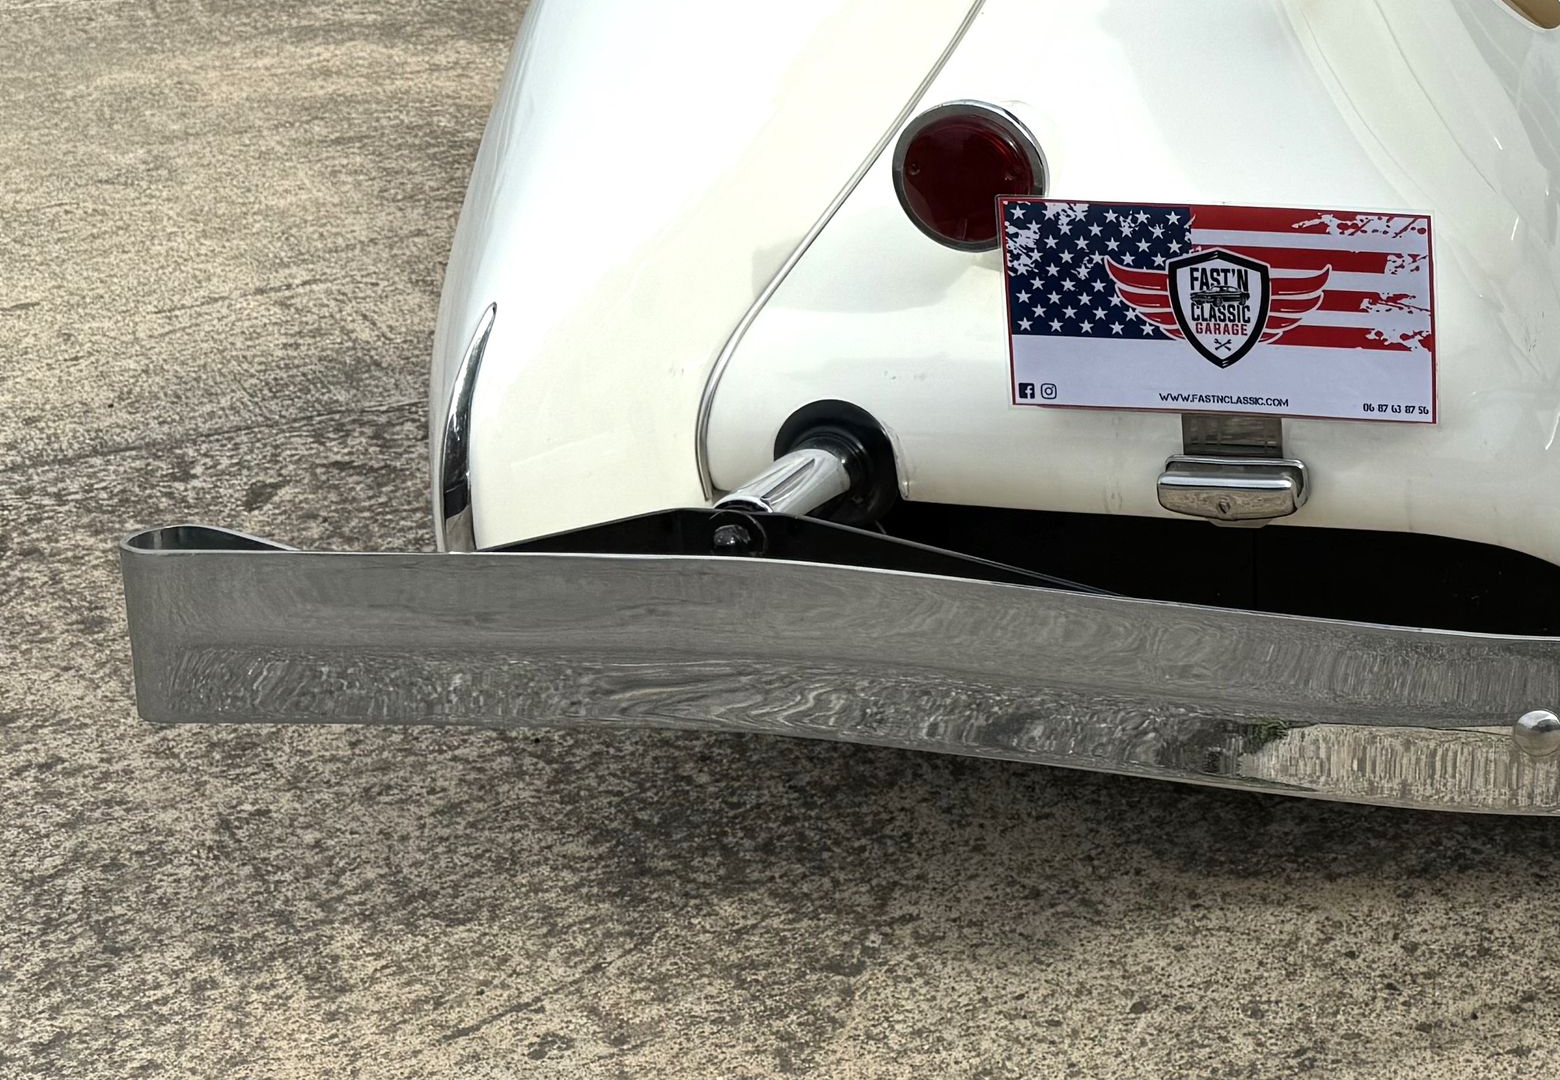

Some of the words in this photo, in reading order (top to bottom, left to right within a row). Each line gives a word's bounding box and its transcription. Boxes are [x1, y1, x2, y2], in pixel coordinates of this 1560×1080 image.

[1189, 267, 1250, 293] FAST'N
[1191, 302, 1251, 324] CLASSIC
[1195, 322, 1248, 336] GARAGE
[1159, 393, 1289, 407] WWW.FASTNCLASSIC.COM
[1362, 403, 1375, 412] 06
[1377, 404, 1389, 413] 87
[1404, 405, 1416, 414] 87
